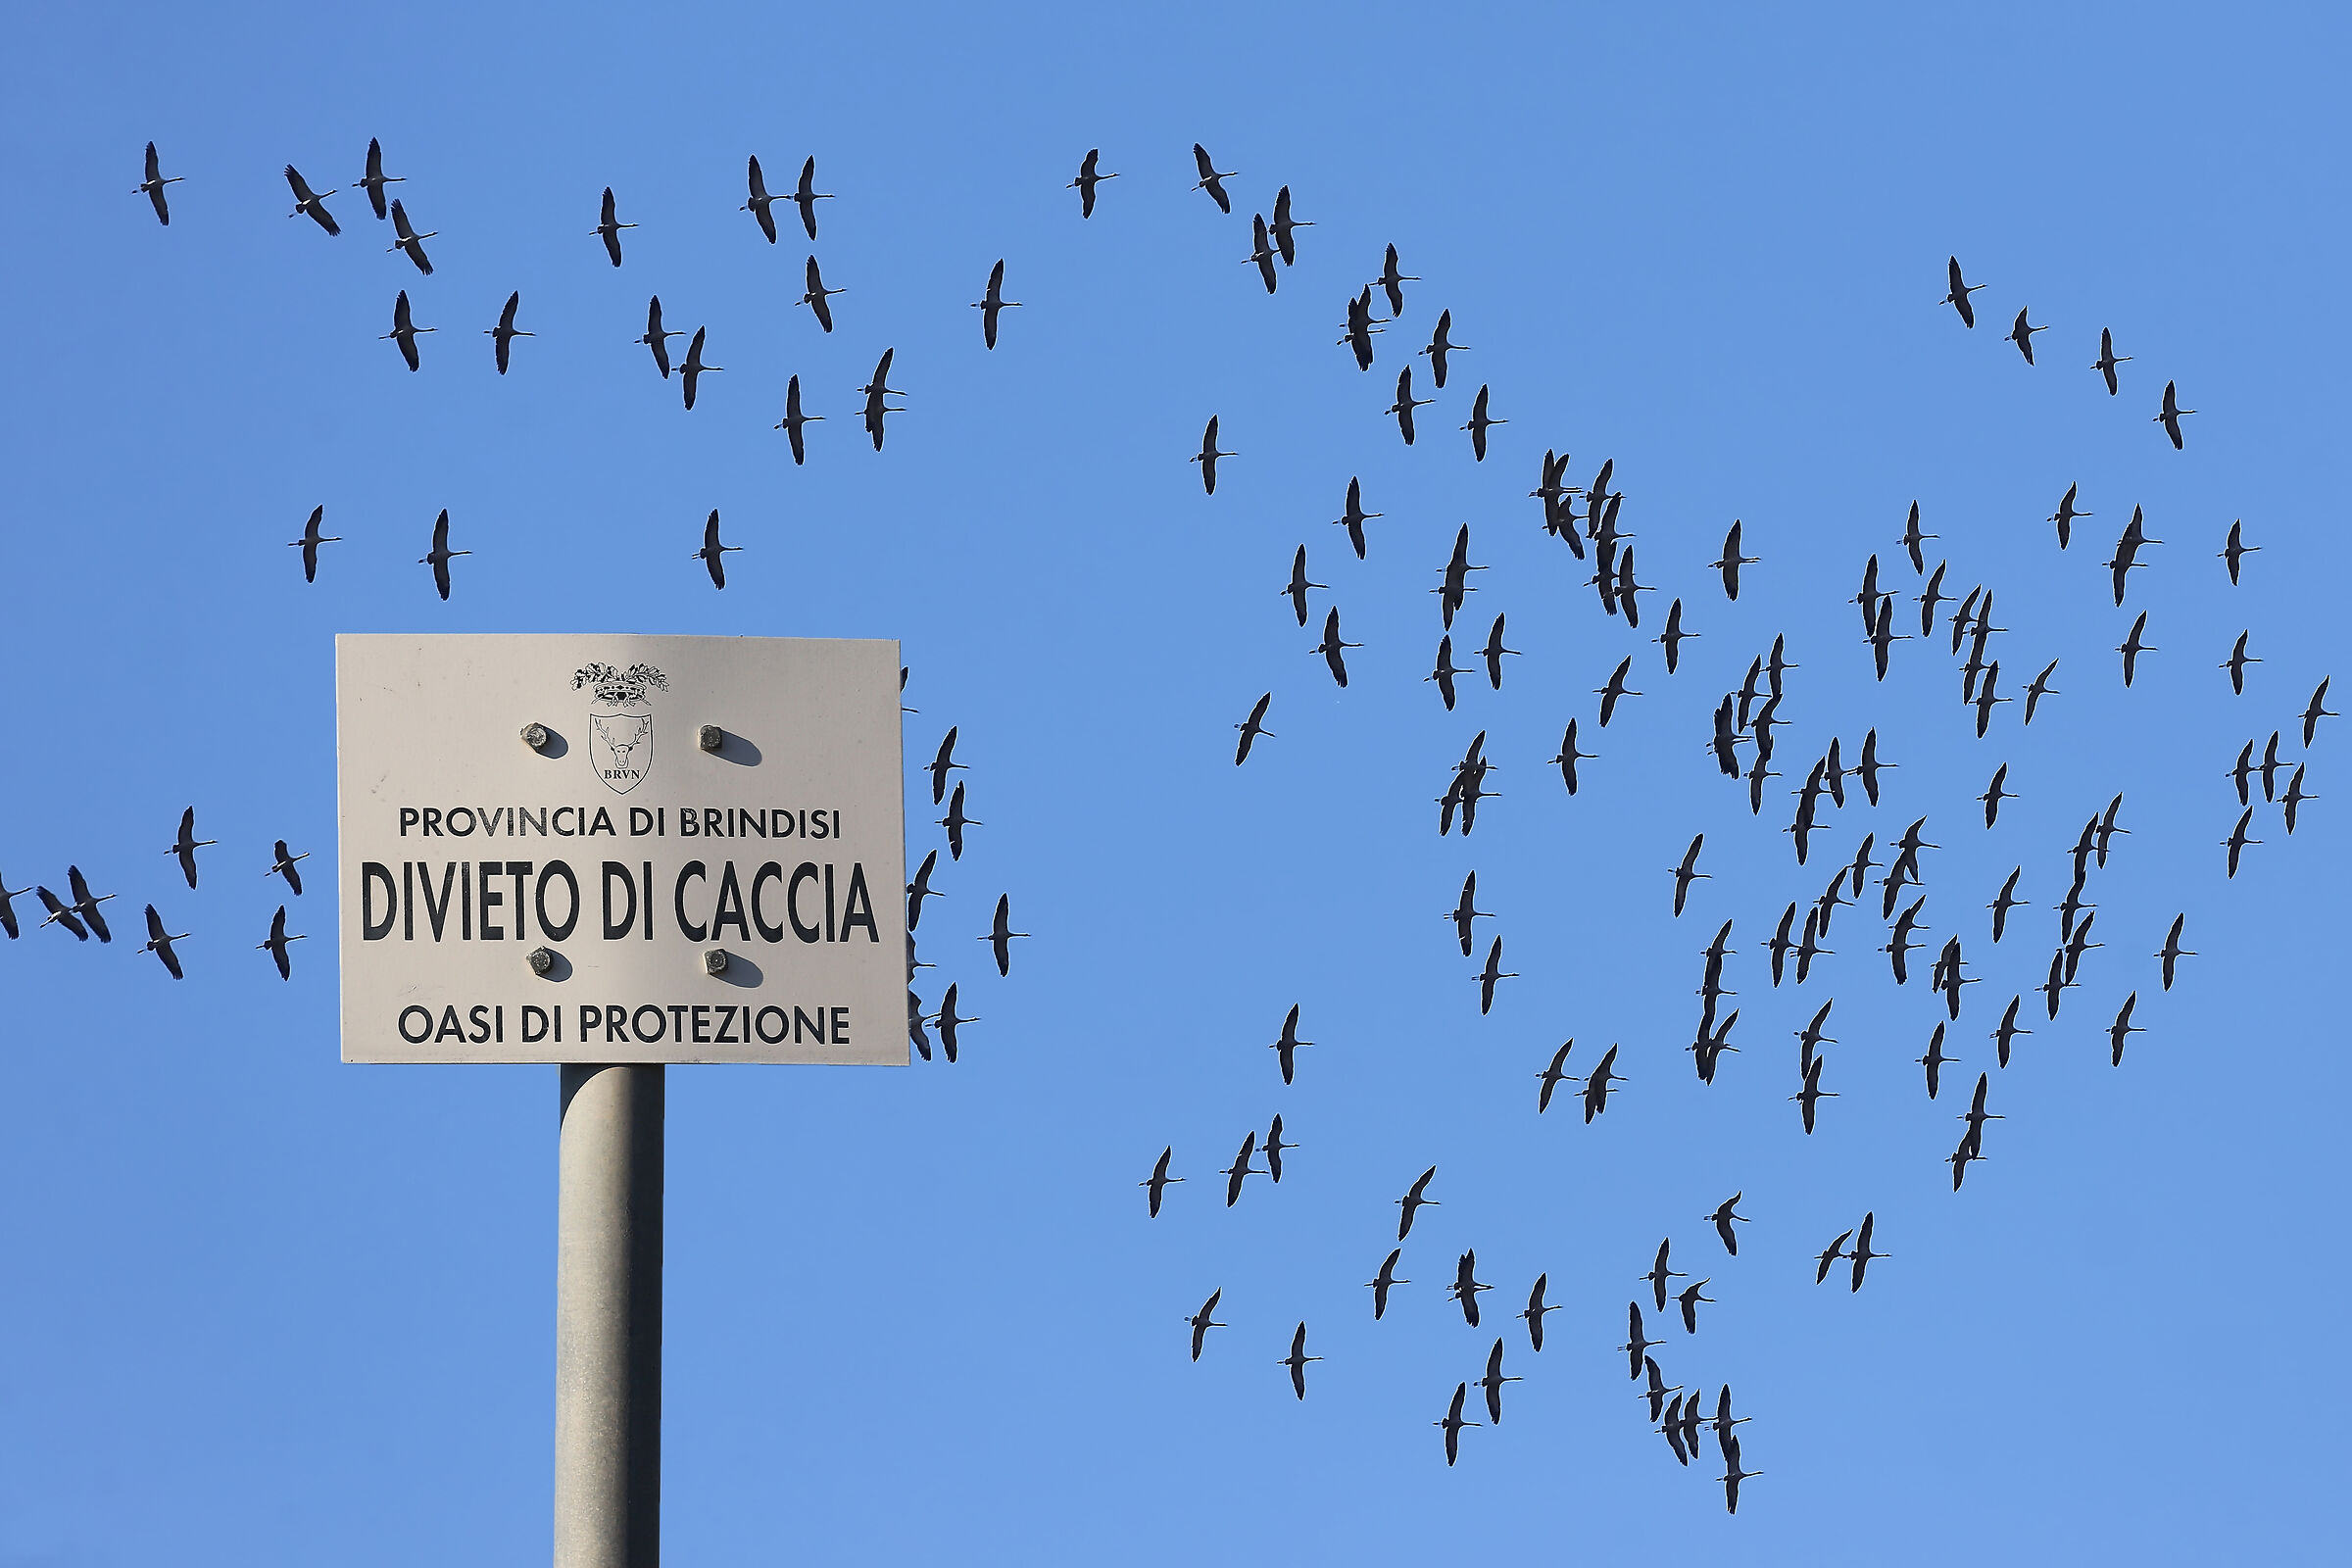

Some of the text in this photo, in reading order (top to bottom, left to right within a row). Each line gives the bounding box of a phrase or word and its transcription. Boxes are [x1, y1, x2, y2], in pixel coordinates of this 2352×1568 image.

[604, 769, 640, 779] BRVN
[400, 807, 840, 839] PROVINCIA DI BRINDISI
[363, 859, 879, 943] DIVIETO DI CACCIA
[399, 1004, 850, 1045] OASI DI PROTEZIONE
